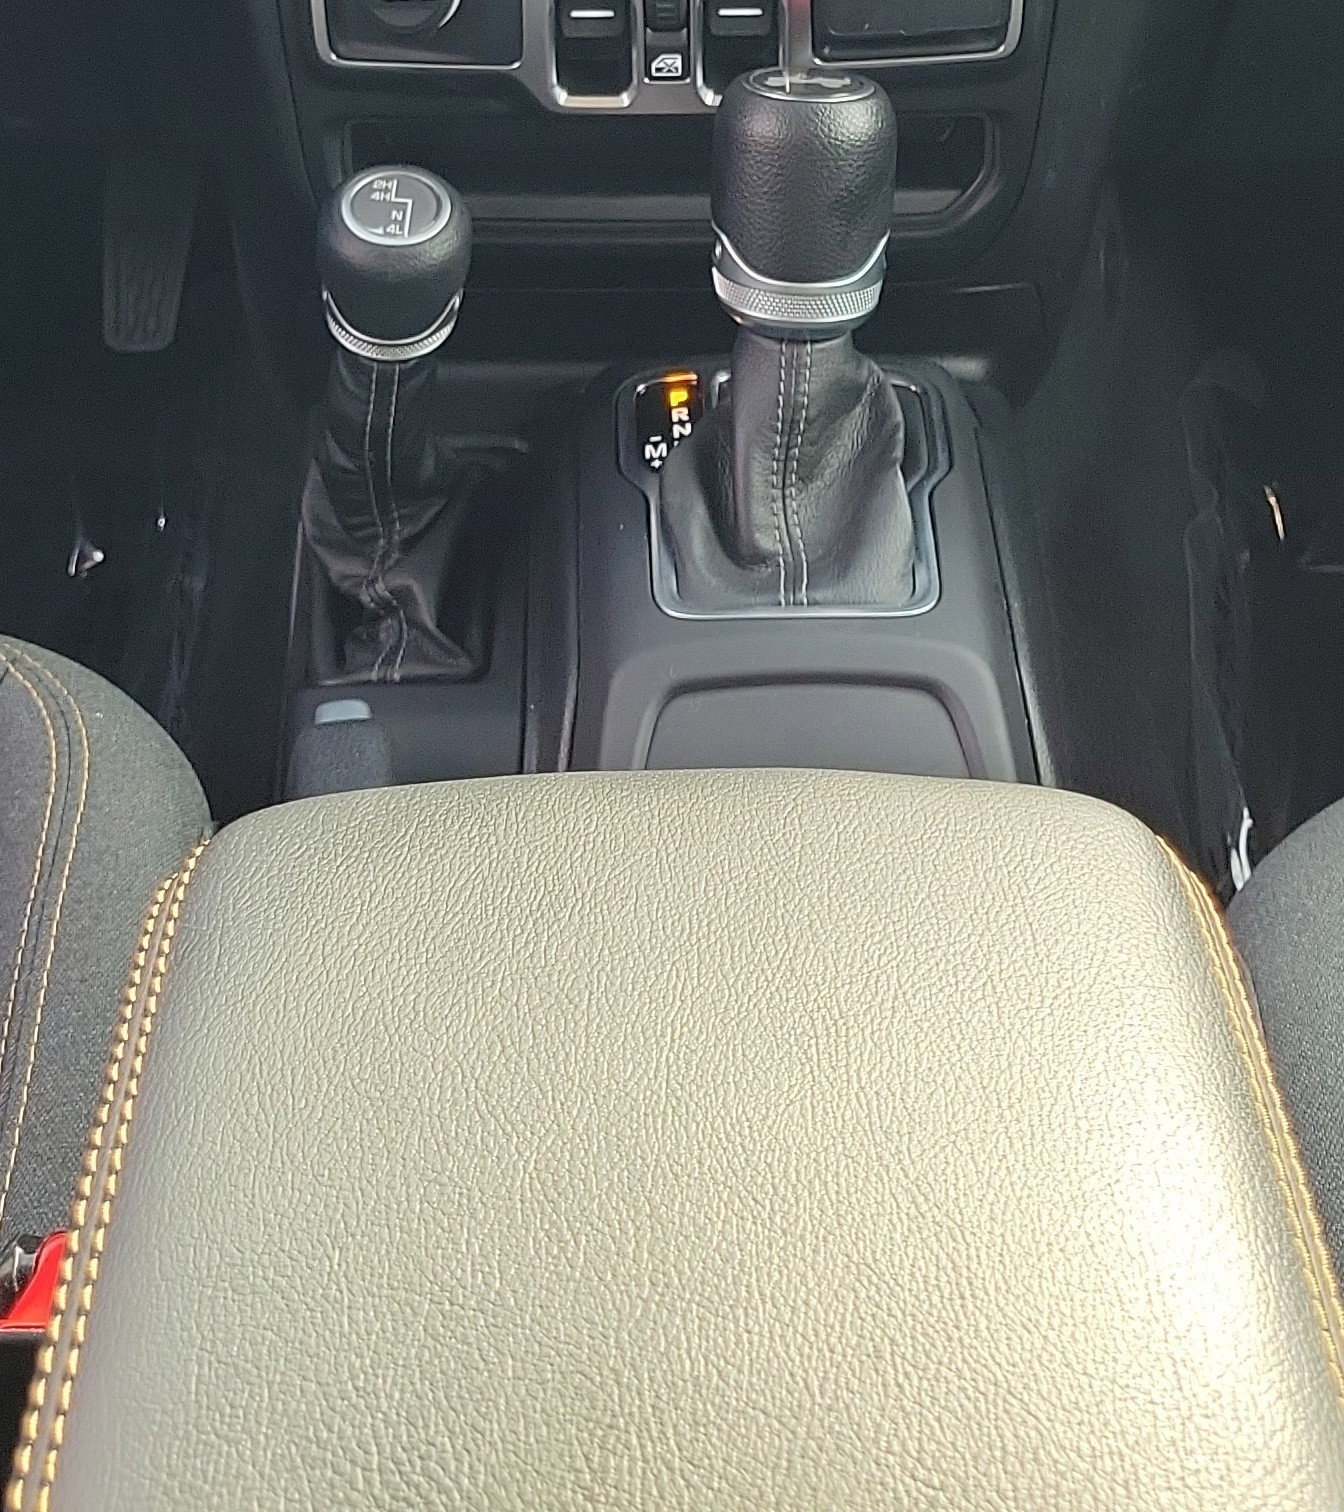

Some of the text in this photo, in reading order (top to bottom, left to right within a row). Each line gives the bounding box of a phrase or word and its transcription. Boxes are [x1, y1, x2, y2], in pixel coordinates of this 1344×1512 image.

[391, 210, 403, 221] N
[669, 390, 689, 407] P
[671, 407, 690, 423] R
[672, 423, 692, 438] N
[644, 442, 668, 460] M
